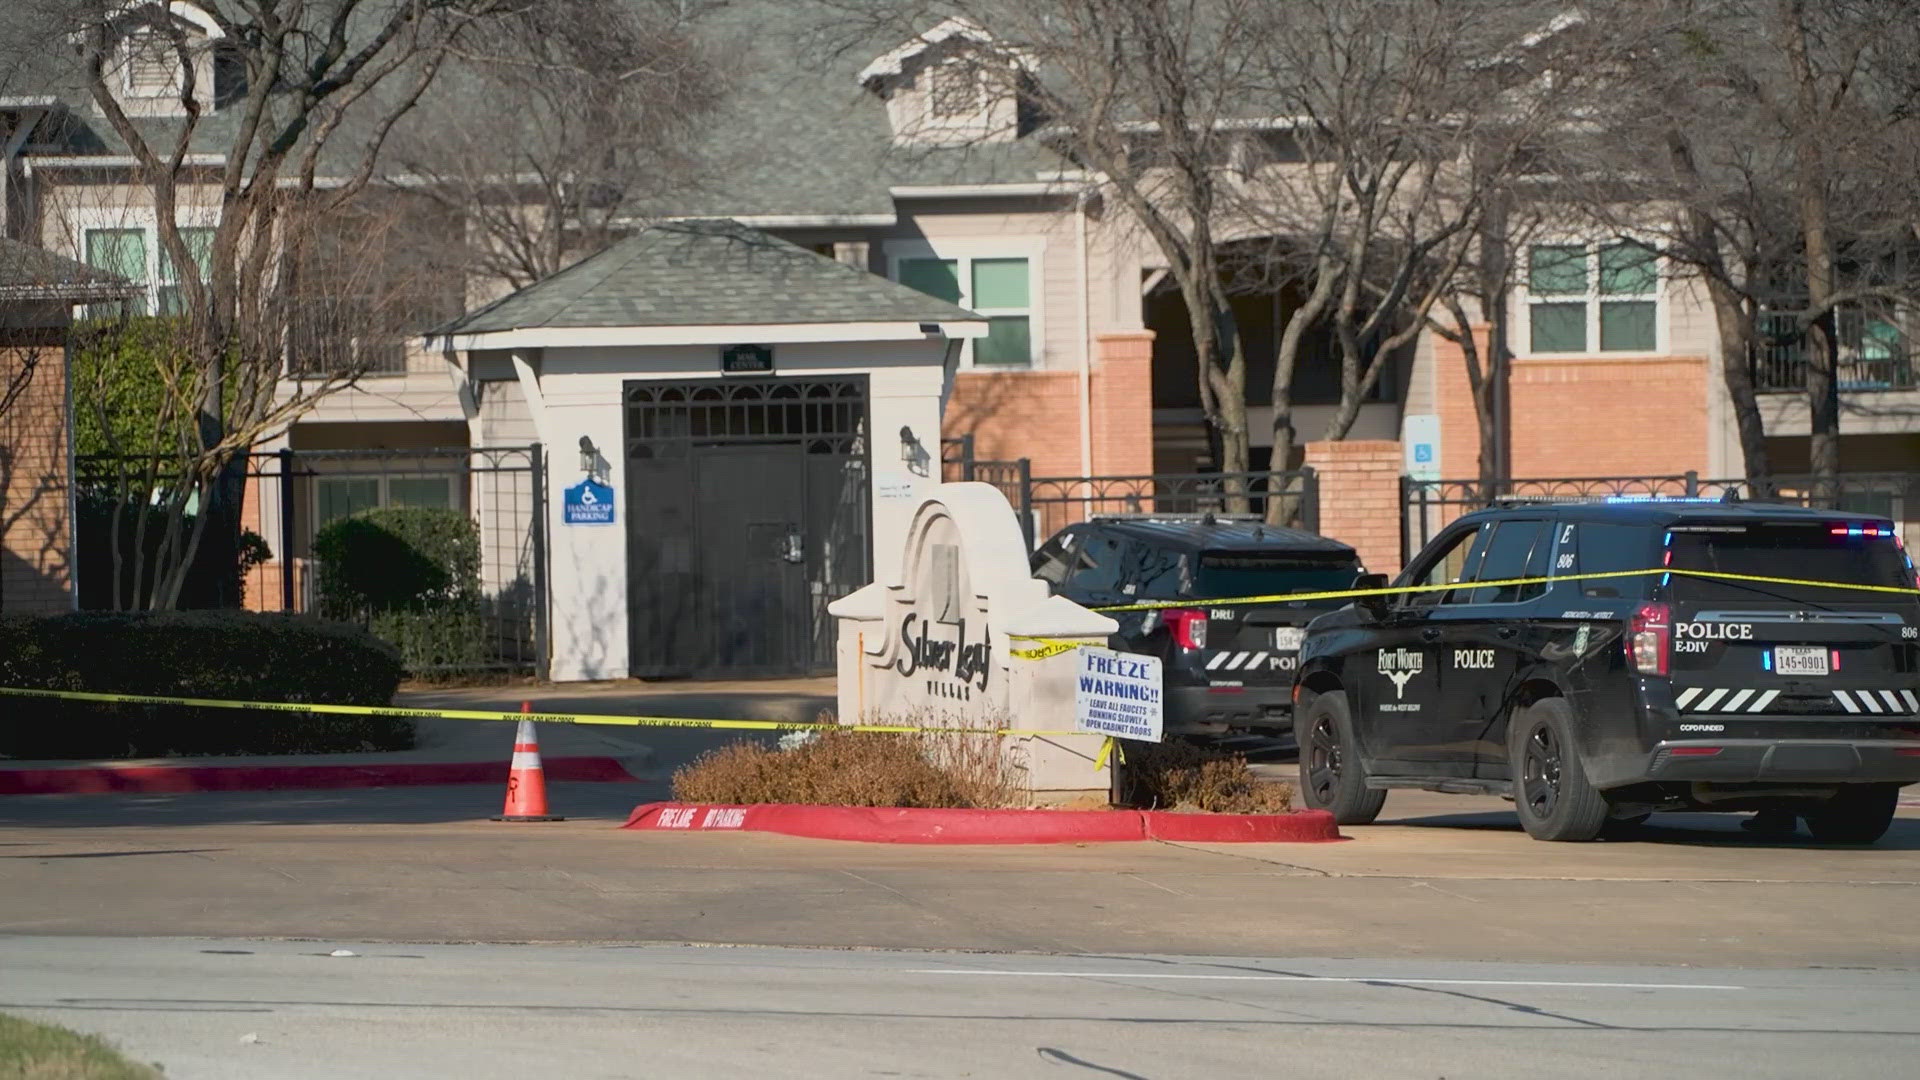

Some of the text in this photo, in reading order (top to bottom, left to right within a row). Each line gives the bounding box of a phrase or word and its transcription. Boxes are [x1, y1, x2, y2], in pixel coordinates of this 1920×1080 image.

[567, 503, 612, 513] HANDICAP
[571, 512, 609, 521] PARKING
[1560, 524, 1575, 544] E
[1556, 553, 1575, 569] 806
[1210, 608, 1235, 620] DRU
[1675, 622, 1754, 640] POLICE
[1901, 627, 1918, 638] 806
[896, 612, 956, 678] Silver
[1675, 641, 1709, 652] E-DIV
[1088, 654, 1150, 680] FREEZE
[1454, 649, 1495, 669] POLICE
[926, 681, 970, 702] VILLAS
[1079, 676, 1159, 704] WARNING!!
[1089, 699, 1147, 715] LEAVE ALL FAUCETS
[1088, 709, 1117, 721] RUNNING
[1117, 714, 1142, 725] SLOWLY
[1086, 719, 1152, 737] OPEN CABINET DOORS
